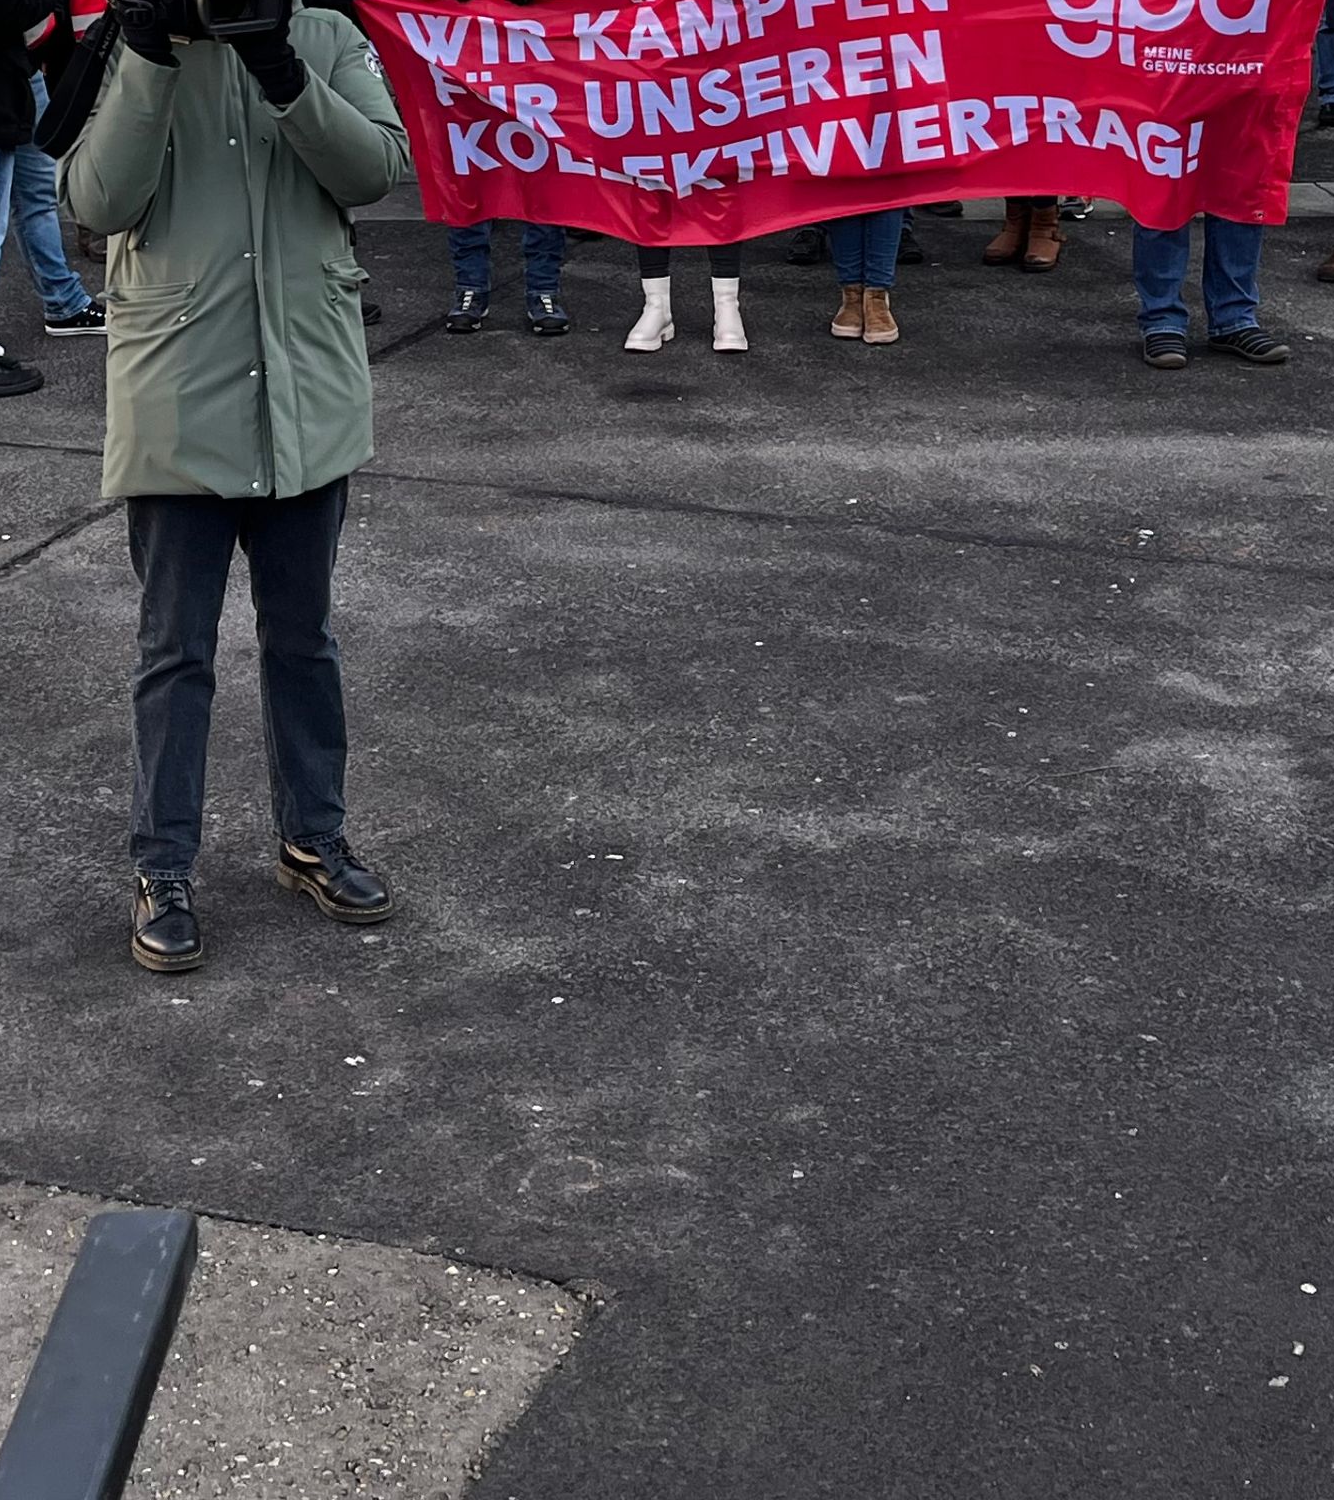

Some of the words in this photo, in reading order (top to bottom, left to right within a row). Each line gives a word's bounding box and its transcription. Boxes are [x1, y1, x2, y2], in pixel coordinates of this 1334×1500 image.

[397, 12, 555, 66] WIR
[1143, 46, 1193, 61] MEINE
[584, 29, 946, 139] UNSEREN
[1142, 58, 1264, 76] GEWERKSCHAFT
